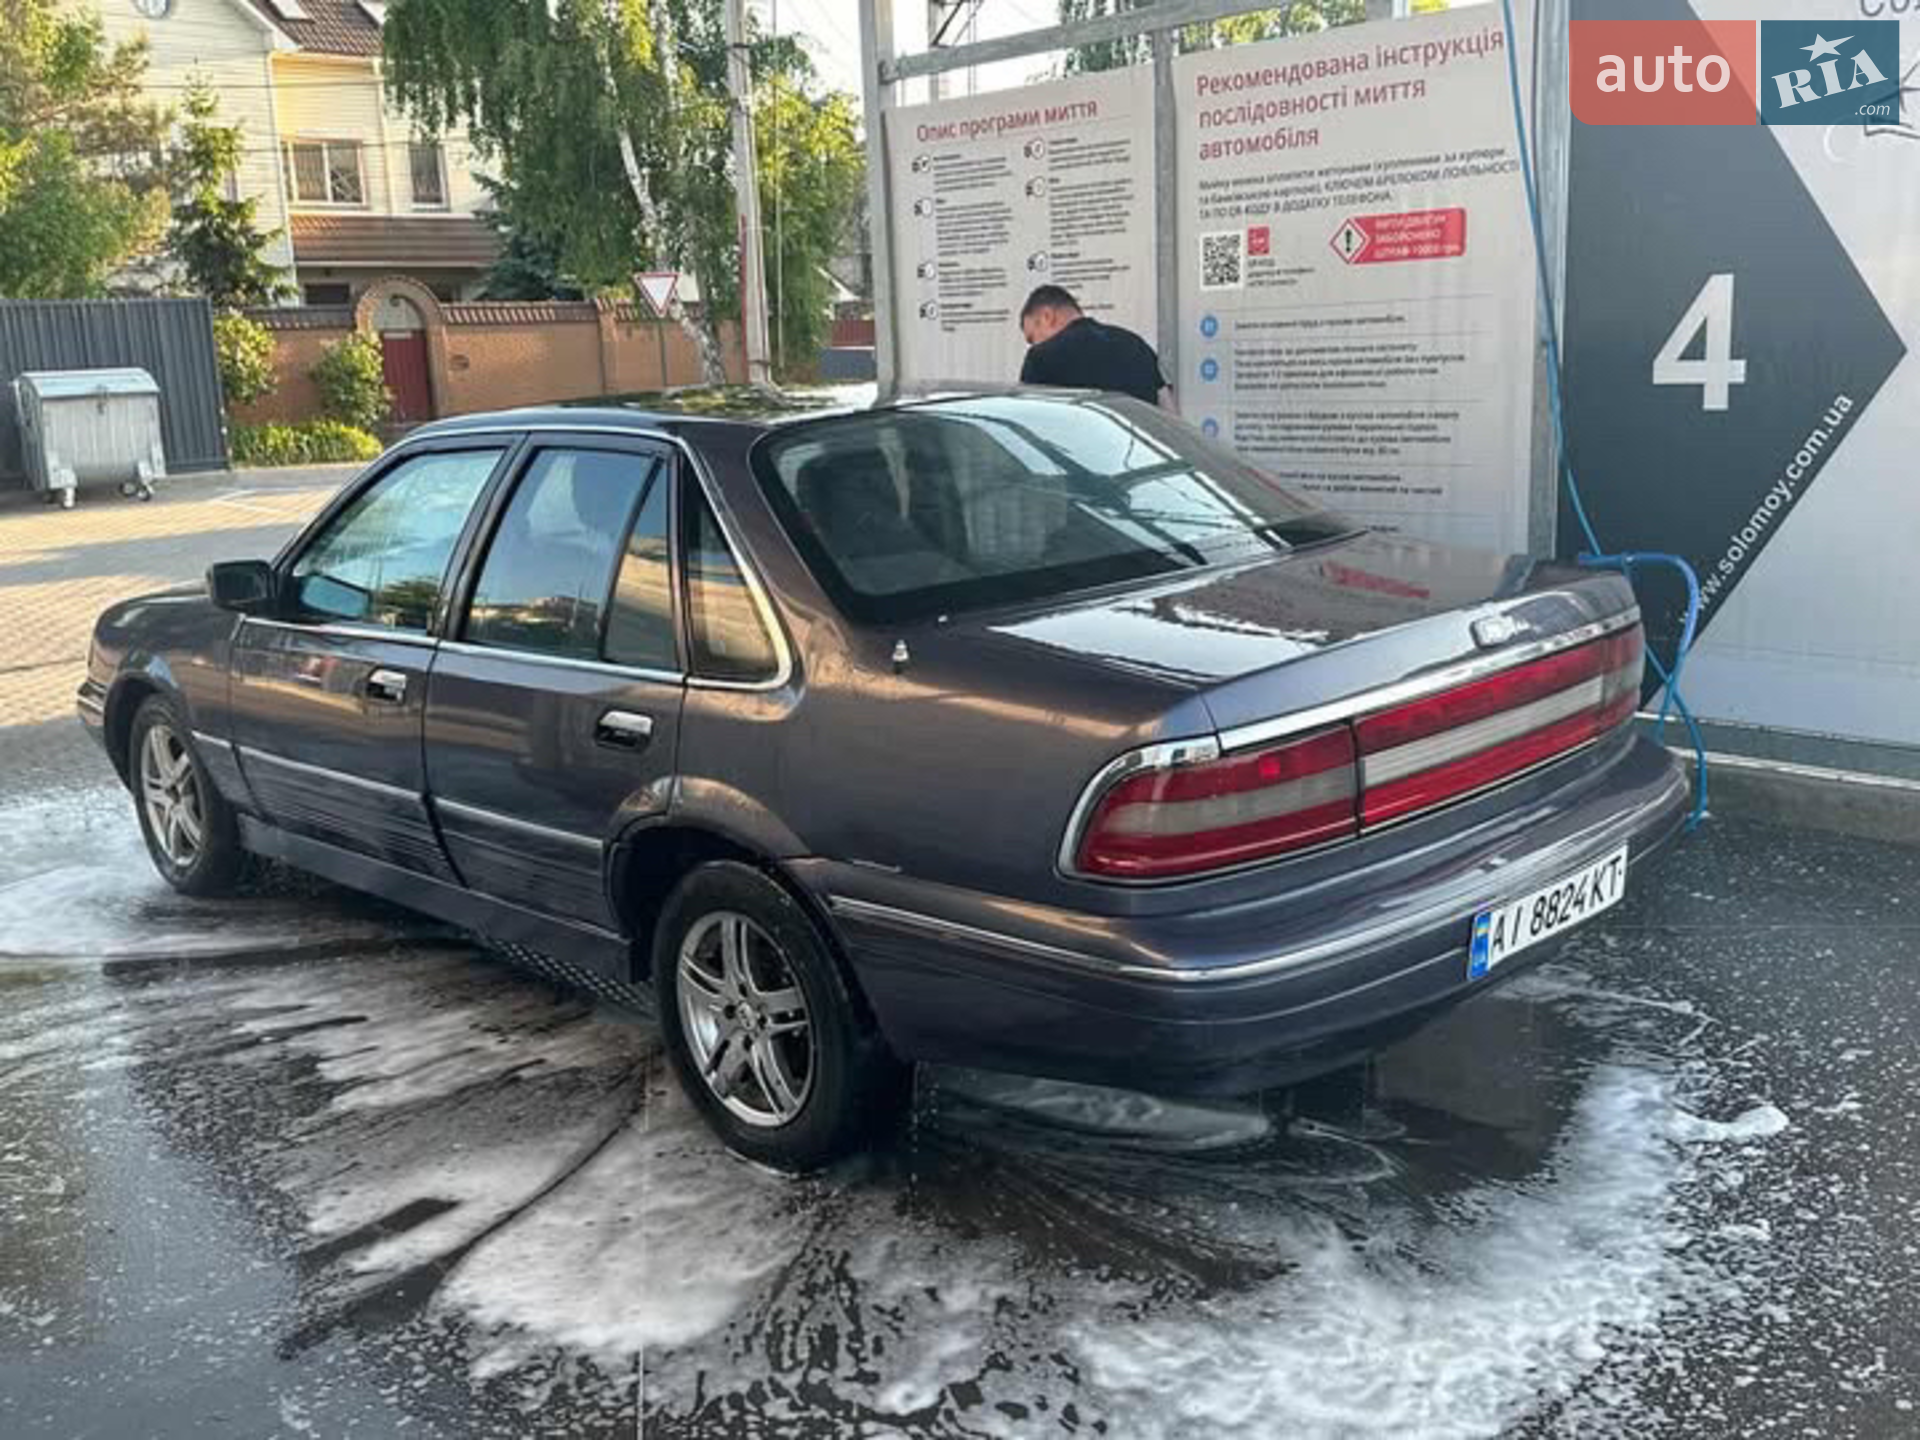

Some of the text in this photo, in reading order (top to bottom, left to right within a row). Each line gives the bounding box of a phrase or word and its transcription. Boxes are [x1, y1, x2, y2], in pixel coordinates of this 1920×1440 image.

[1197, 29, 1504, 96] Рекомендована інструкція
[917, 100, 1098, 143] Опис програми миття
[1200, 79, 1426, 128] послідовності миття
[1200, 127, 1319, 160] автомобіля
[1653, 274, 1746, 410] 4
[1493, 907, 1523, 952] AI
